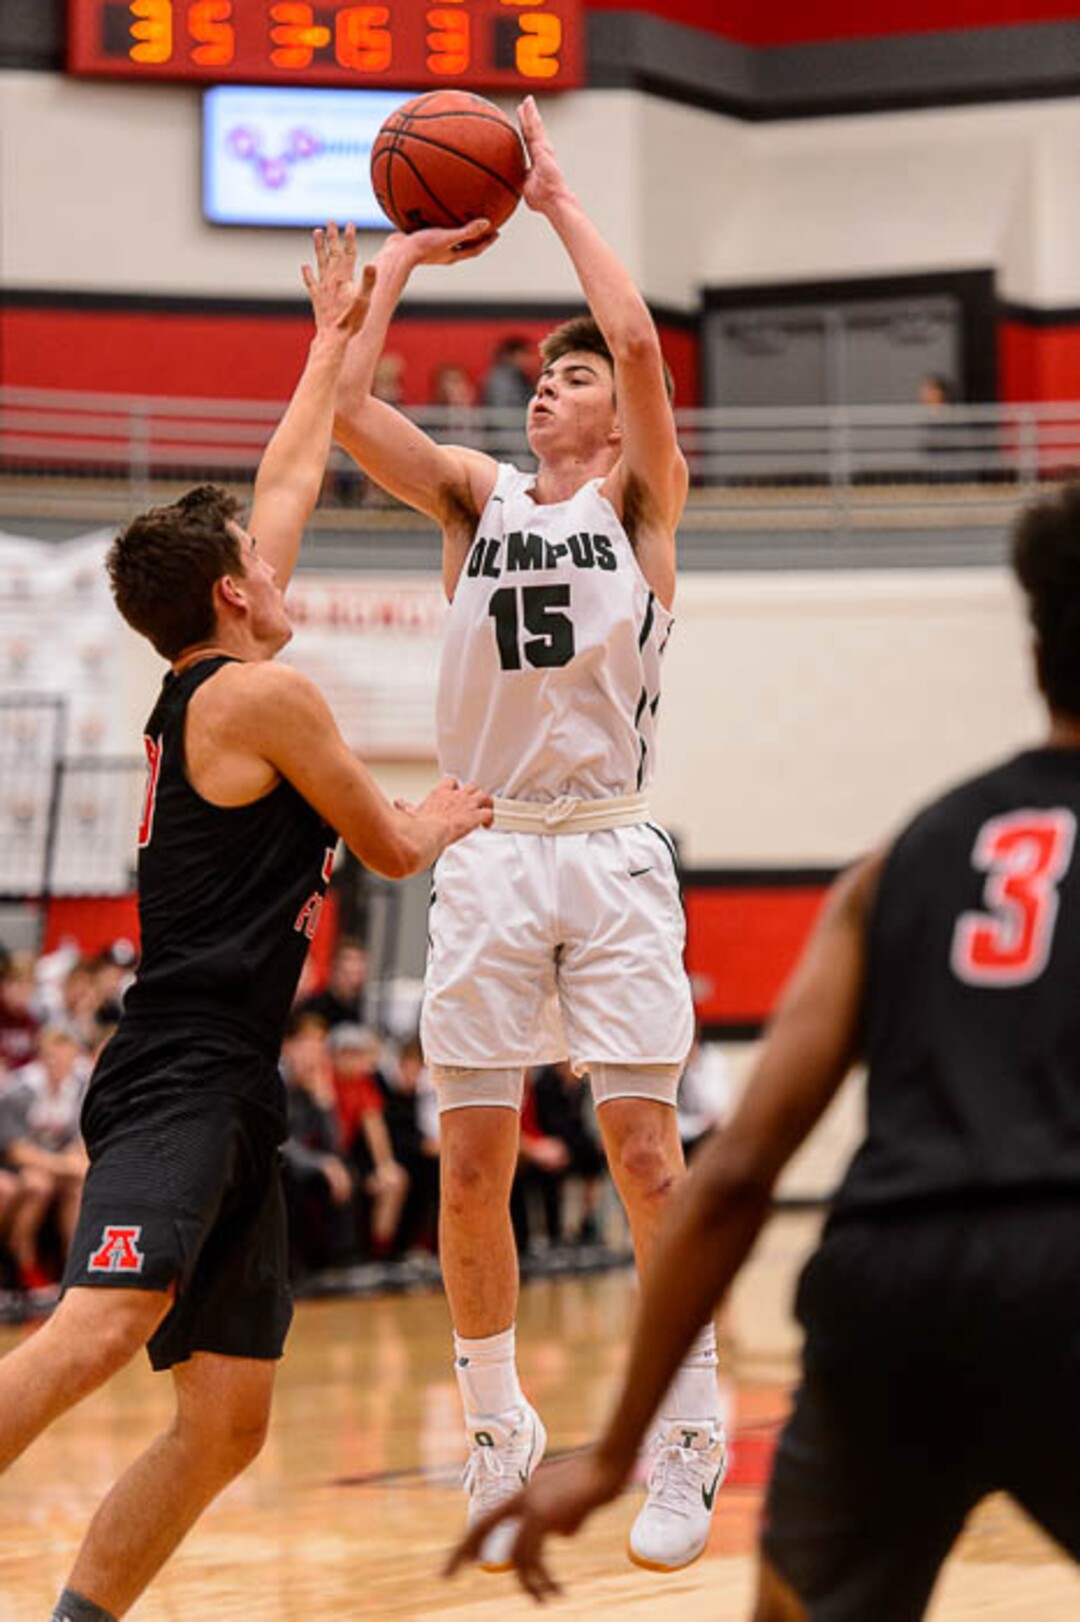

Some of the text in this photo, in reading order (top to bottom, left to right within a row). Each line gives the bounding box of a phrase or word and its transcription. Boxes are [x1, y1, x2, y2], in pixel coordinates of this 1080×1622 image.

[515, 13, 562, 78] 2
[467, 530, 618, 579] OLMPUS
[489, 583, 576, 671] 15
[949, 807, 1078, 989] 3
[87, 1225, 145, 1273] A
[680, 1429, 699, 1449] T
